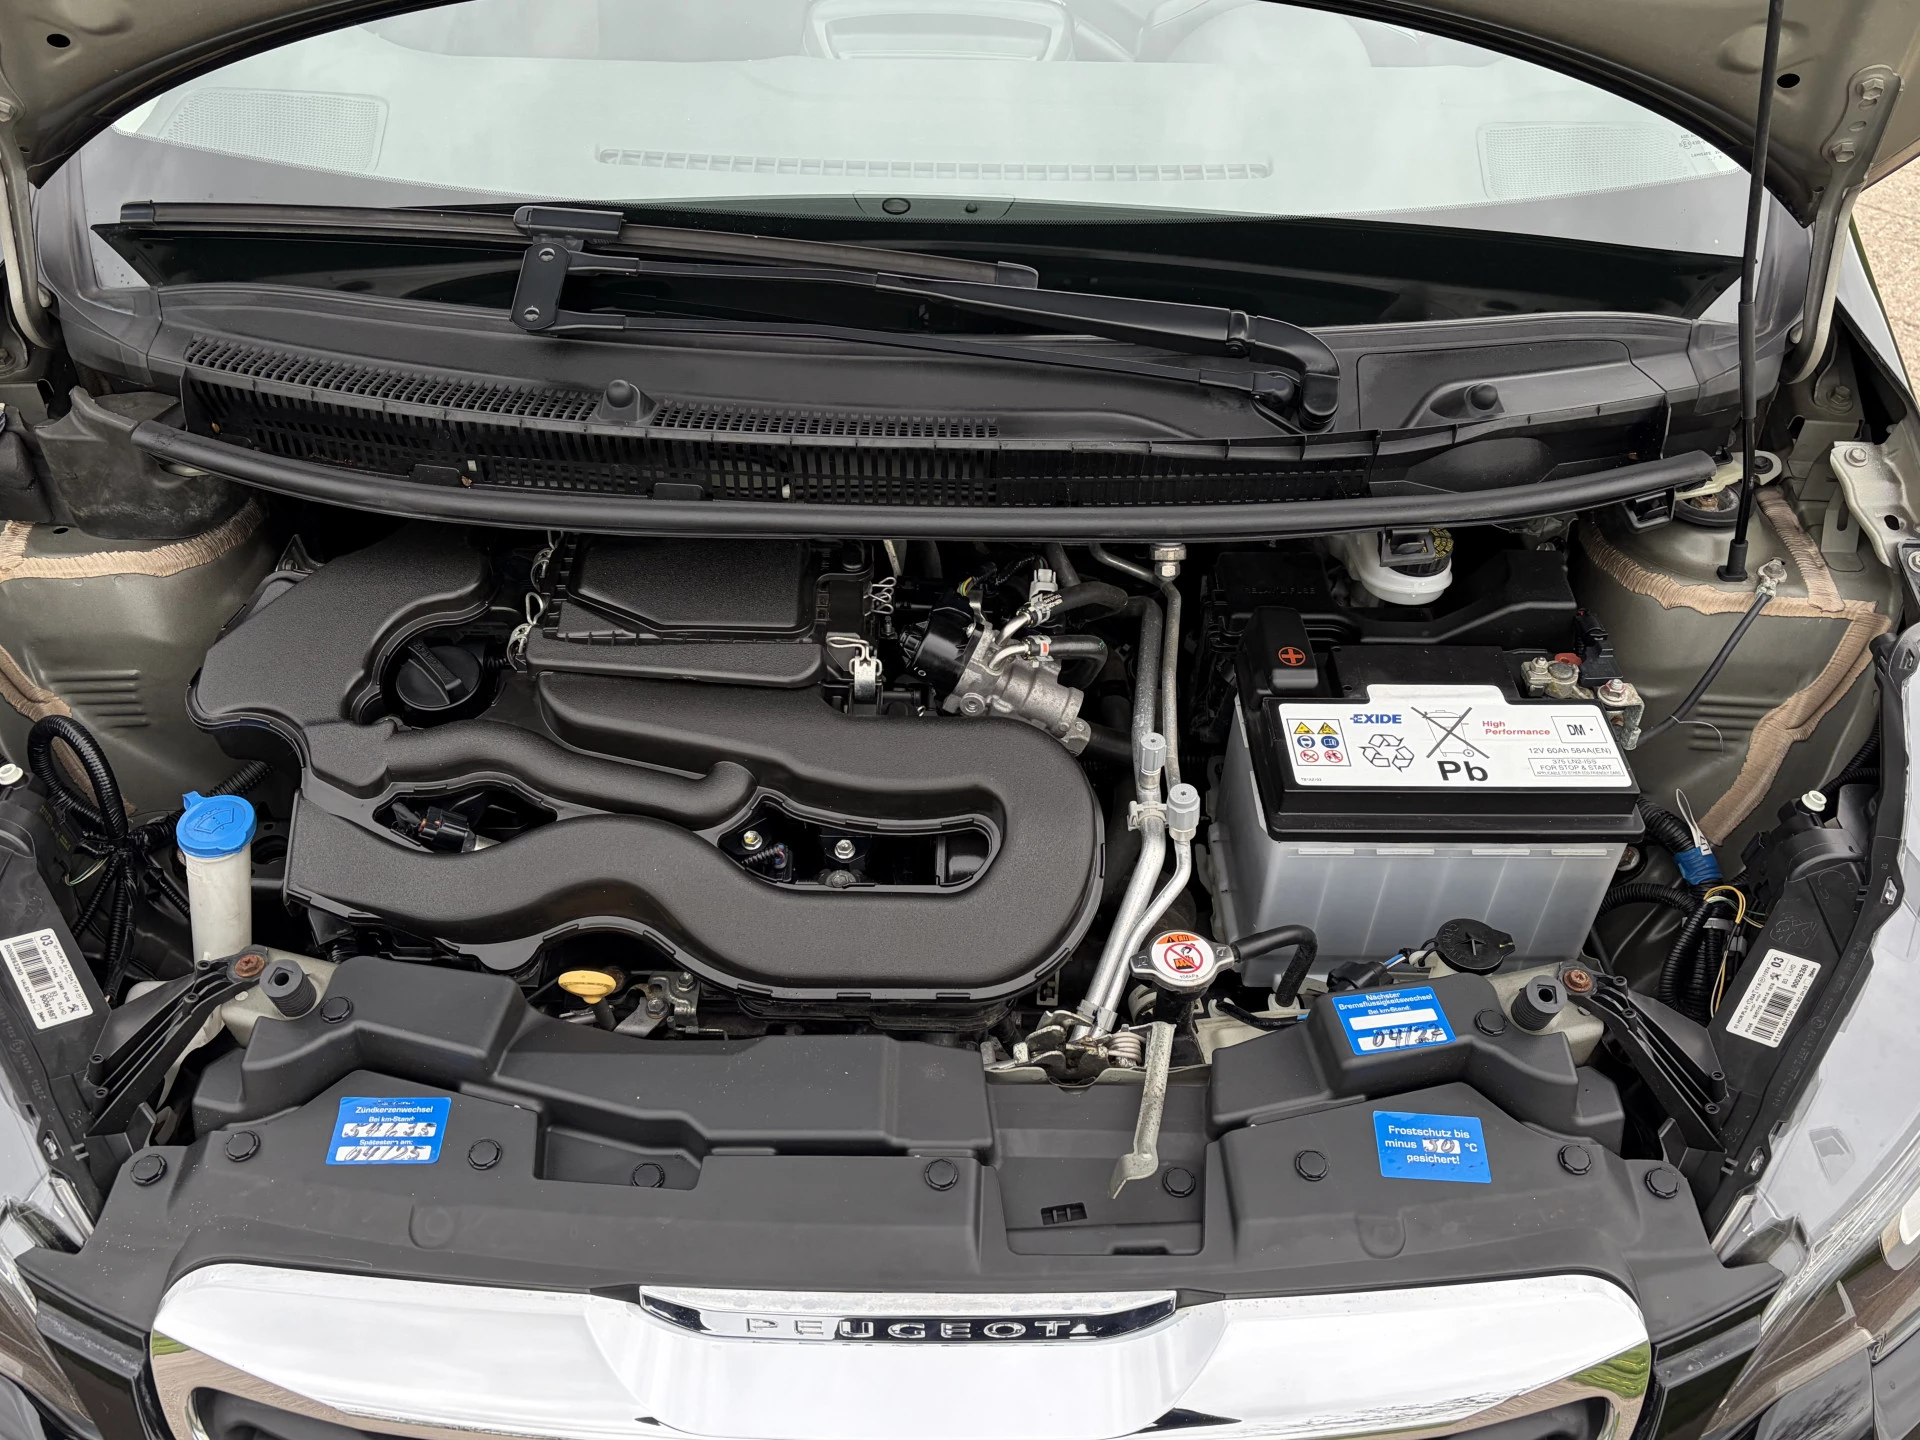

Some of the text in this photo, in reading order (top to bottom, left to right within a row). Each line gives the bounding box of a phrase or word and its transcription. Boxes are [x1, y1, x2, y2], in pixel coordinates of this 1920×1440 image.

[1350, 714, 1402, 724] EXIDE
[1482, 720, 1506, 728] High
[1485, 728, 1550, 736] Performance
[1567, 724, 1586, 736] DM
[1570, 747, 1612, 755] 584A(EN)
[1437, 761, 1489, 781] Pb
[39, 934, 54, 946] 03
[1769, 956, 1784, 968] 03
[355, 1106, 434, 1114] Zündkerzenwechsel
[1388, 1125, 1471, 1139] Frostschutz bis
[1385, 1139, 1418, 1149] minus
[1464, 1142, 1478, 1153] °C
[1406, 1154, 1460, 1165] gesichert!
[746, 1317, 1071, 1339] PEUGEOT
